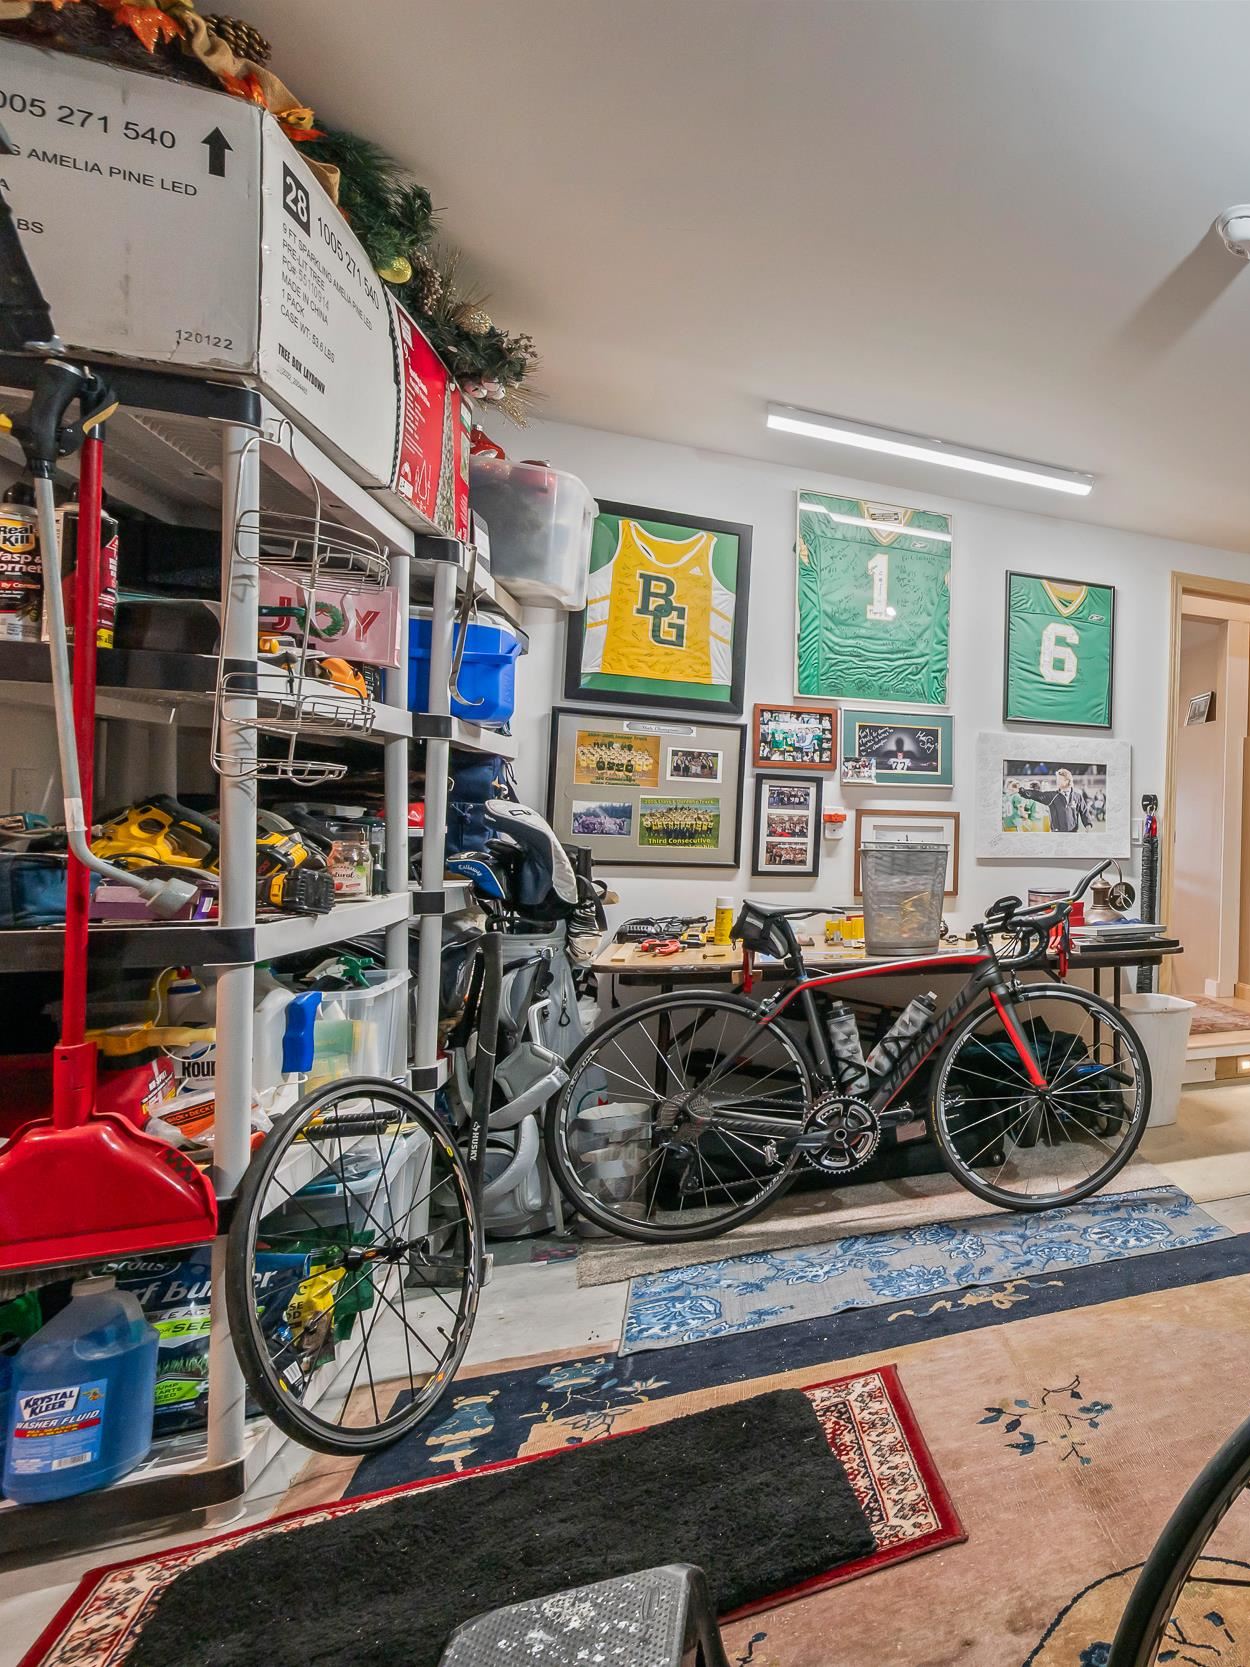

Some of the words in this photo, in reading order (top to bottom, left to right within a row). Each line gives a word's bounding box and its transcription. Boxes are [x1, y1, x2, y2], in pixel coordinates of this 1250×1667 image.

[56, 105, 109, 134] 271
[123, 121, 176, 149] 540
[27, 148, 103, 176] AMELIA
[109, 166, 155, 188] PINE
[160, 178, 198, 196] LED
[285, 175, 308, 223] 28
[16, 218, 44, 234] BS
[298, 239, 333, 284] SPARKLING
[317, 216, 344, 262] 1005
[345, 251, 362, 288] 271
[363, 276, 379, 311] 540
[309, 266, 325, 292] TREE
[281, 270, 301, 299] MADE
[309, 299, 329, 326] CHINA
[286, 292, 305, 318] PACK
[280, 304, 299, 329] CASE
[174, 328, 234, 351] 120122
[278, 342, 291, 364] TREE
[303, 365, 326, 395] LAYDOWN
[2, 534, 31, 547] Kill
[0, 562, 42, 574] ornet
[866, 553, 897, 621] 1
[1039, 622, 1080, 685] 6
[668, 837, 711, 845] Consecutive
[469, 1132, 480, 1161] HUSKY
[23, 1390, 75, 1411] KRYSTAL
[28, 1400, 66, 1418] KLEER
[15, 1419, 60, 1430] WASHER
[60, 1409, 101, 1425] FLUID
